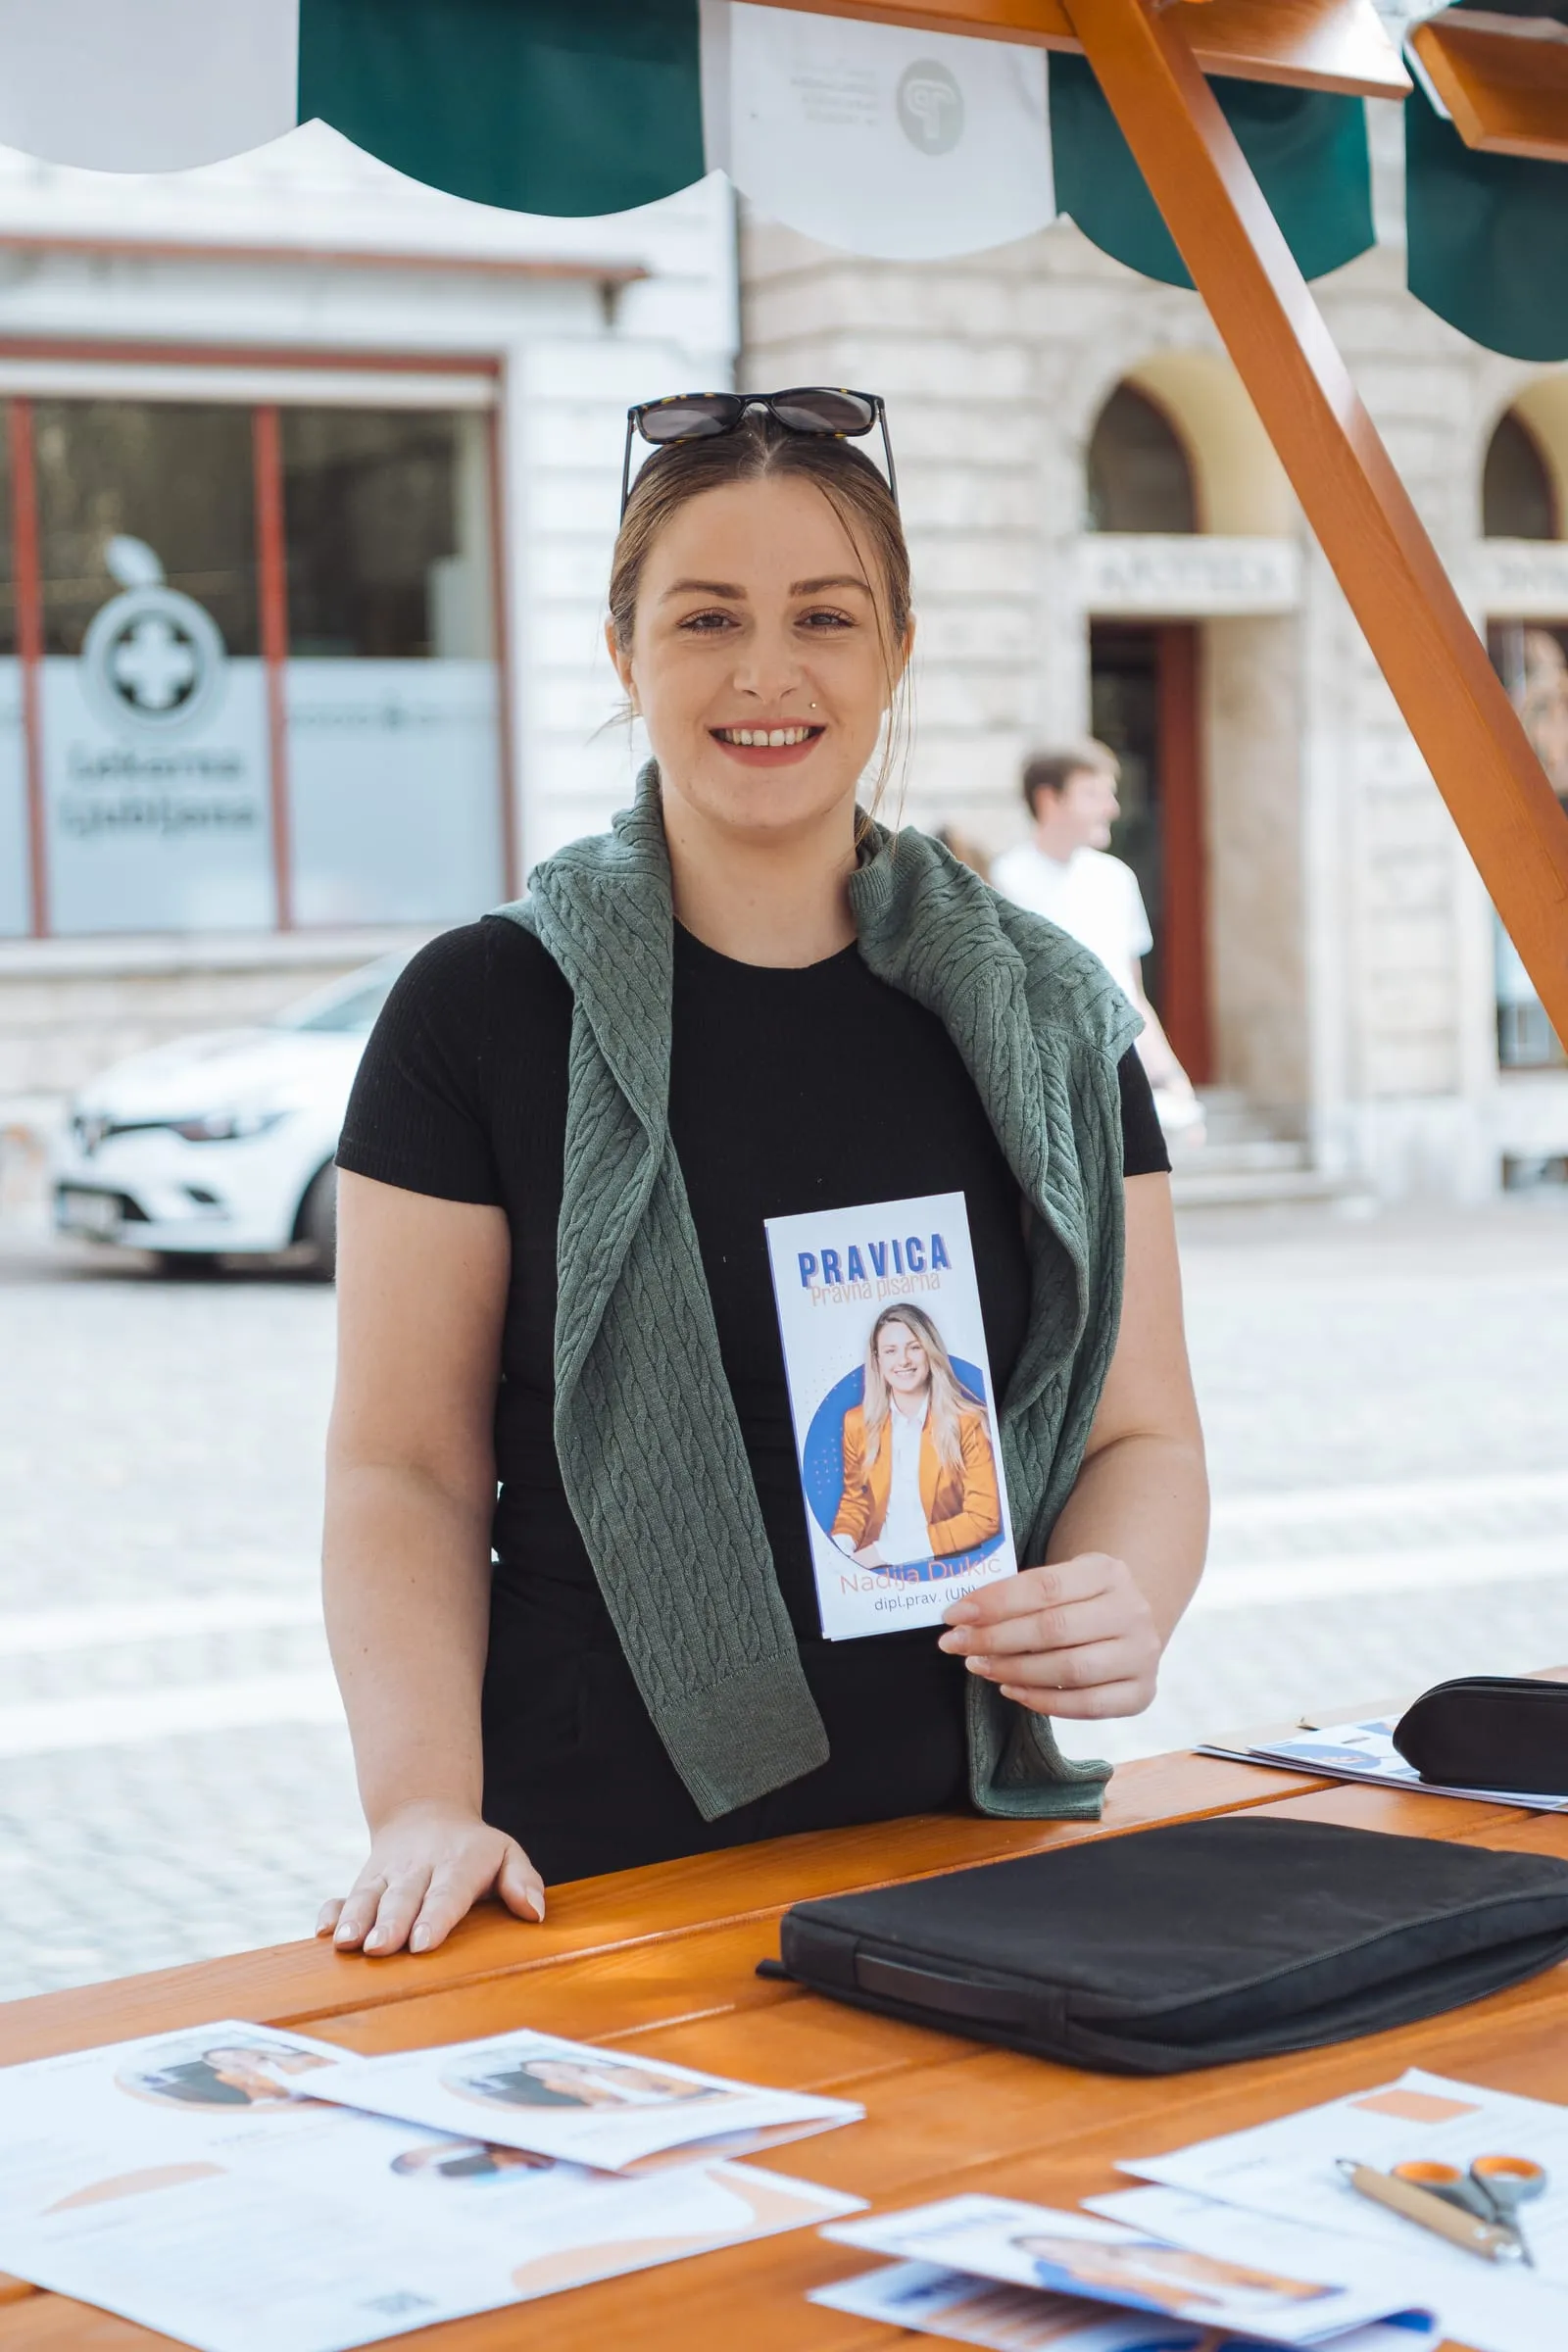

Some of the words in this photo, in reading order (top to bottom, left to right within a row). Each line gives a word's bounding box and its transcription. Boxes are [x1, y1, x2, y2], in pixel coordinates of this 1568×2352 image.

[798, 1234, 951, 1288] PRAVICA
[877, 1273, 941, 1301] pisarna
[840, 1566, 919, 1595] Nadija
